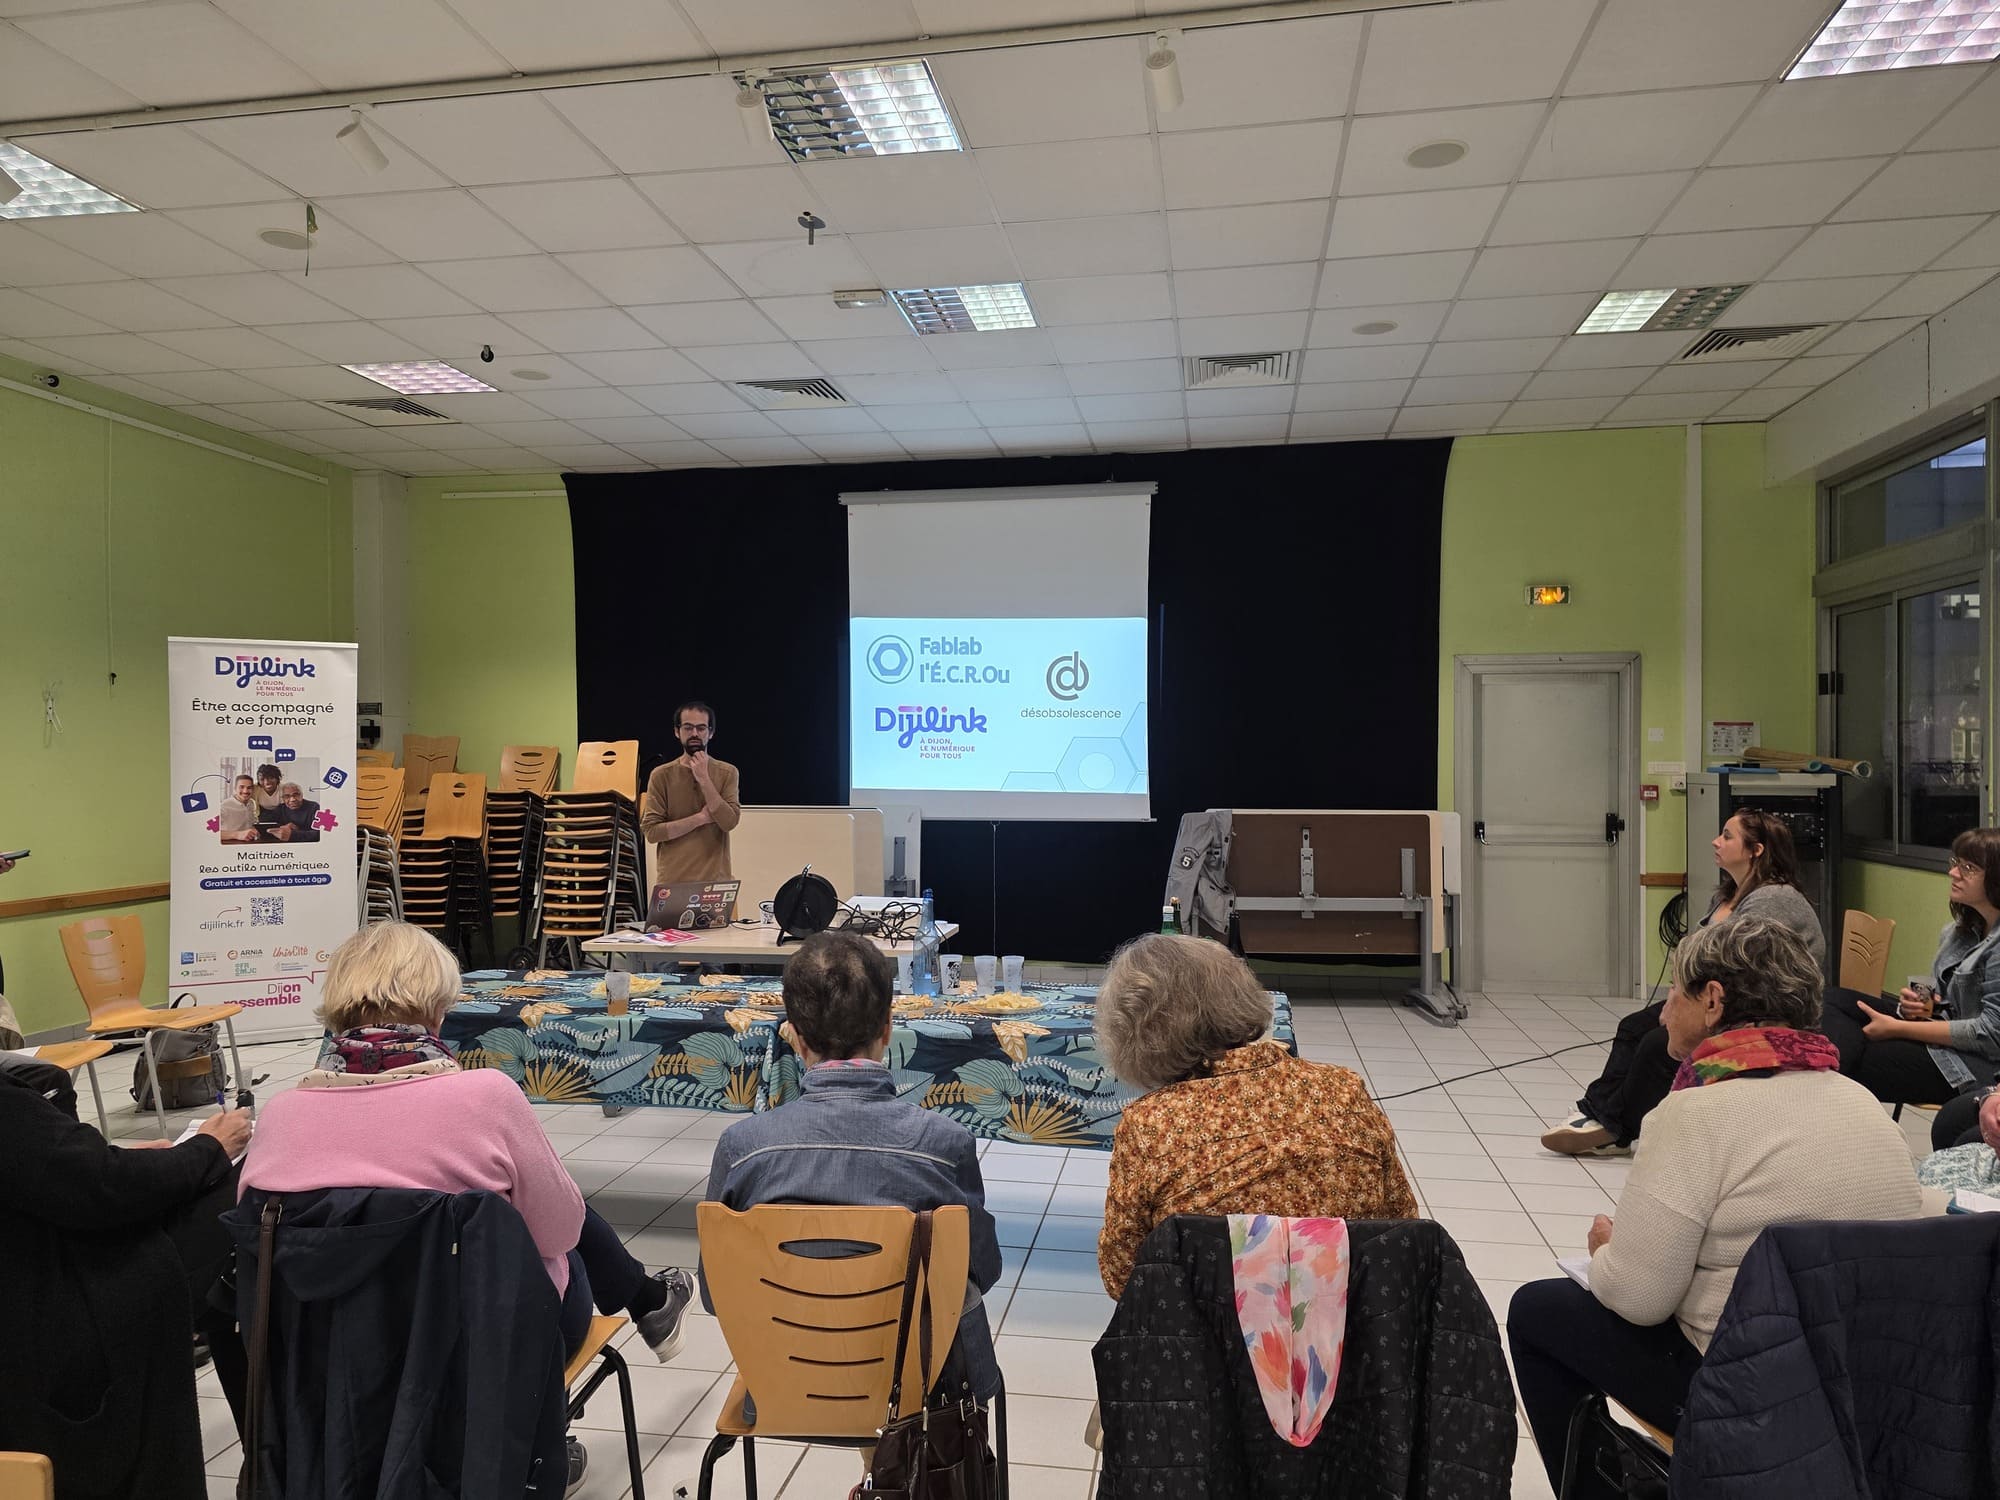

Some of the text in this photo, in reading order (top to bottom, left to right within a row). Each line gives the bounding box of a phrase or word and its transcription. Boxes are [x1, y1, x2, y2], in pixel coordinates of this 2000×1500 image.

[919, 637, 982, 655] Fablab
[215, 655, 316, 688] Dijilink
[919, 661, 1010, 684] l'É.C.R.Ou
[265, 684, 305, 692] NUMÉRIQUE
[192, 698, 334, 715] Être accompagné
[1020, 707, 1122, 719] désobsolescence
[215, 715, 316, 727] et se former
[875, 705, 987, 749] Dijilink
[931, 743, 976, 753] NUMÉRIQUE
[199, 861, 330, 874] les outils numériques
[1182, 856, 1192, 867] 5
[204, 880, 233, 888] Gratuit
[244, 878, 287, 886] accessible
[311, 875, 327, 884] âge
[199, 920, 244, 931] dijilink.fr
[267, 982, 301, 997] Dijon
[223, 993, 301, 1008] ssemble
